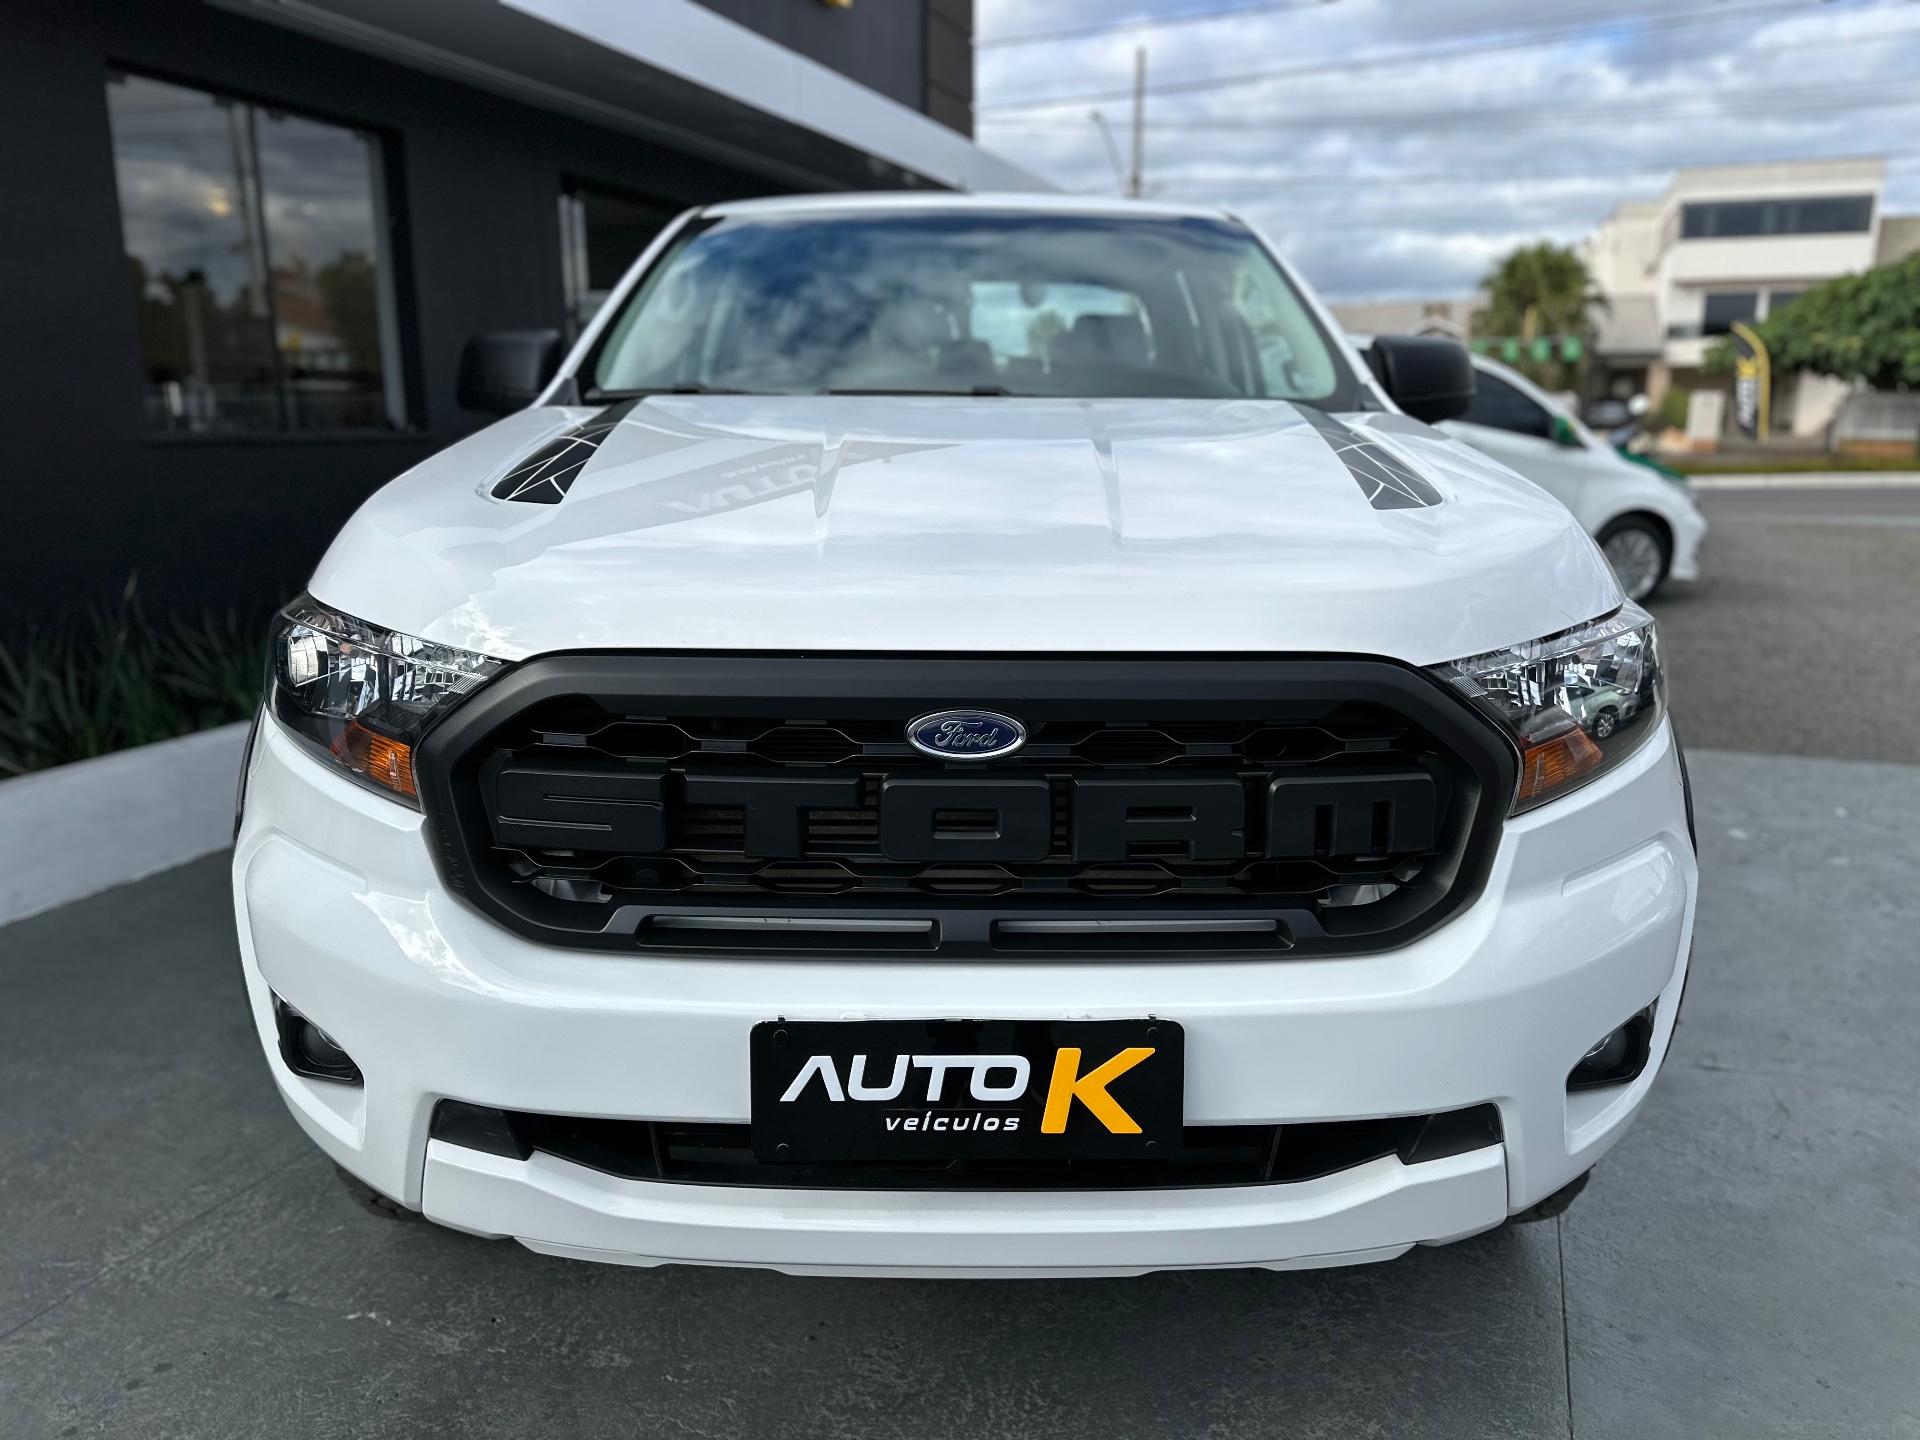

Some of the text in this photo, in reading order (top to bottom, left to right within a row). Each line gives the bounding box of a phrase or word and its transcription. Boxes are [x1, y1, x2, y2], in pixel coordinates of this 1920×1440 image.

[934, 719, 999, 748] Ford
[496, 768, 1436, 861] STORM
[779, 1047, 1156, 1134] AUTO K
